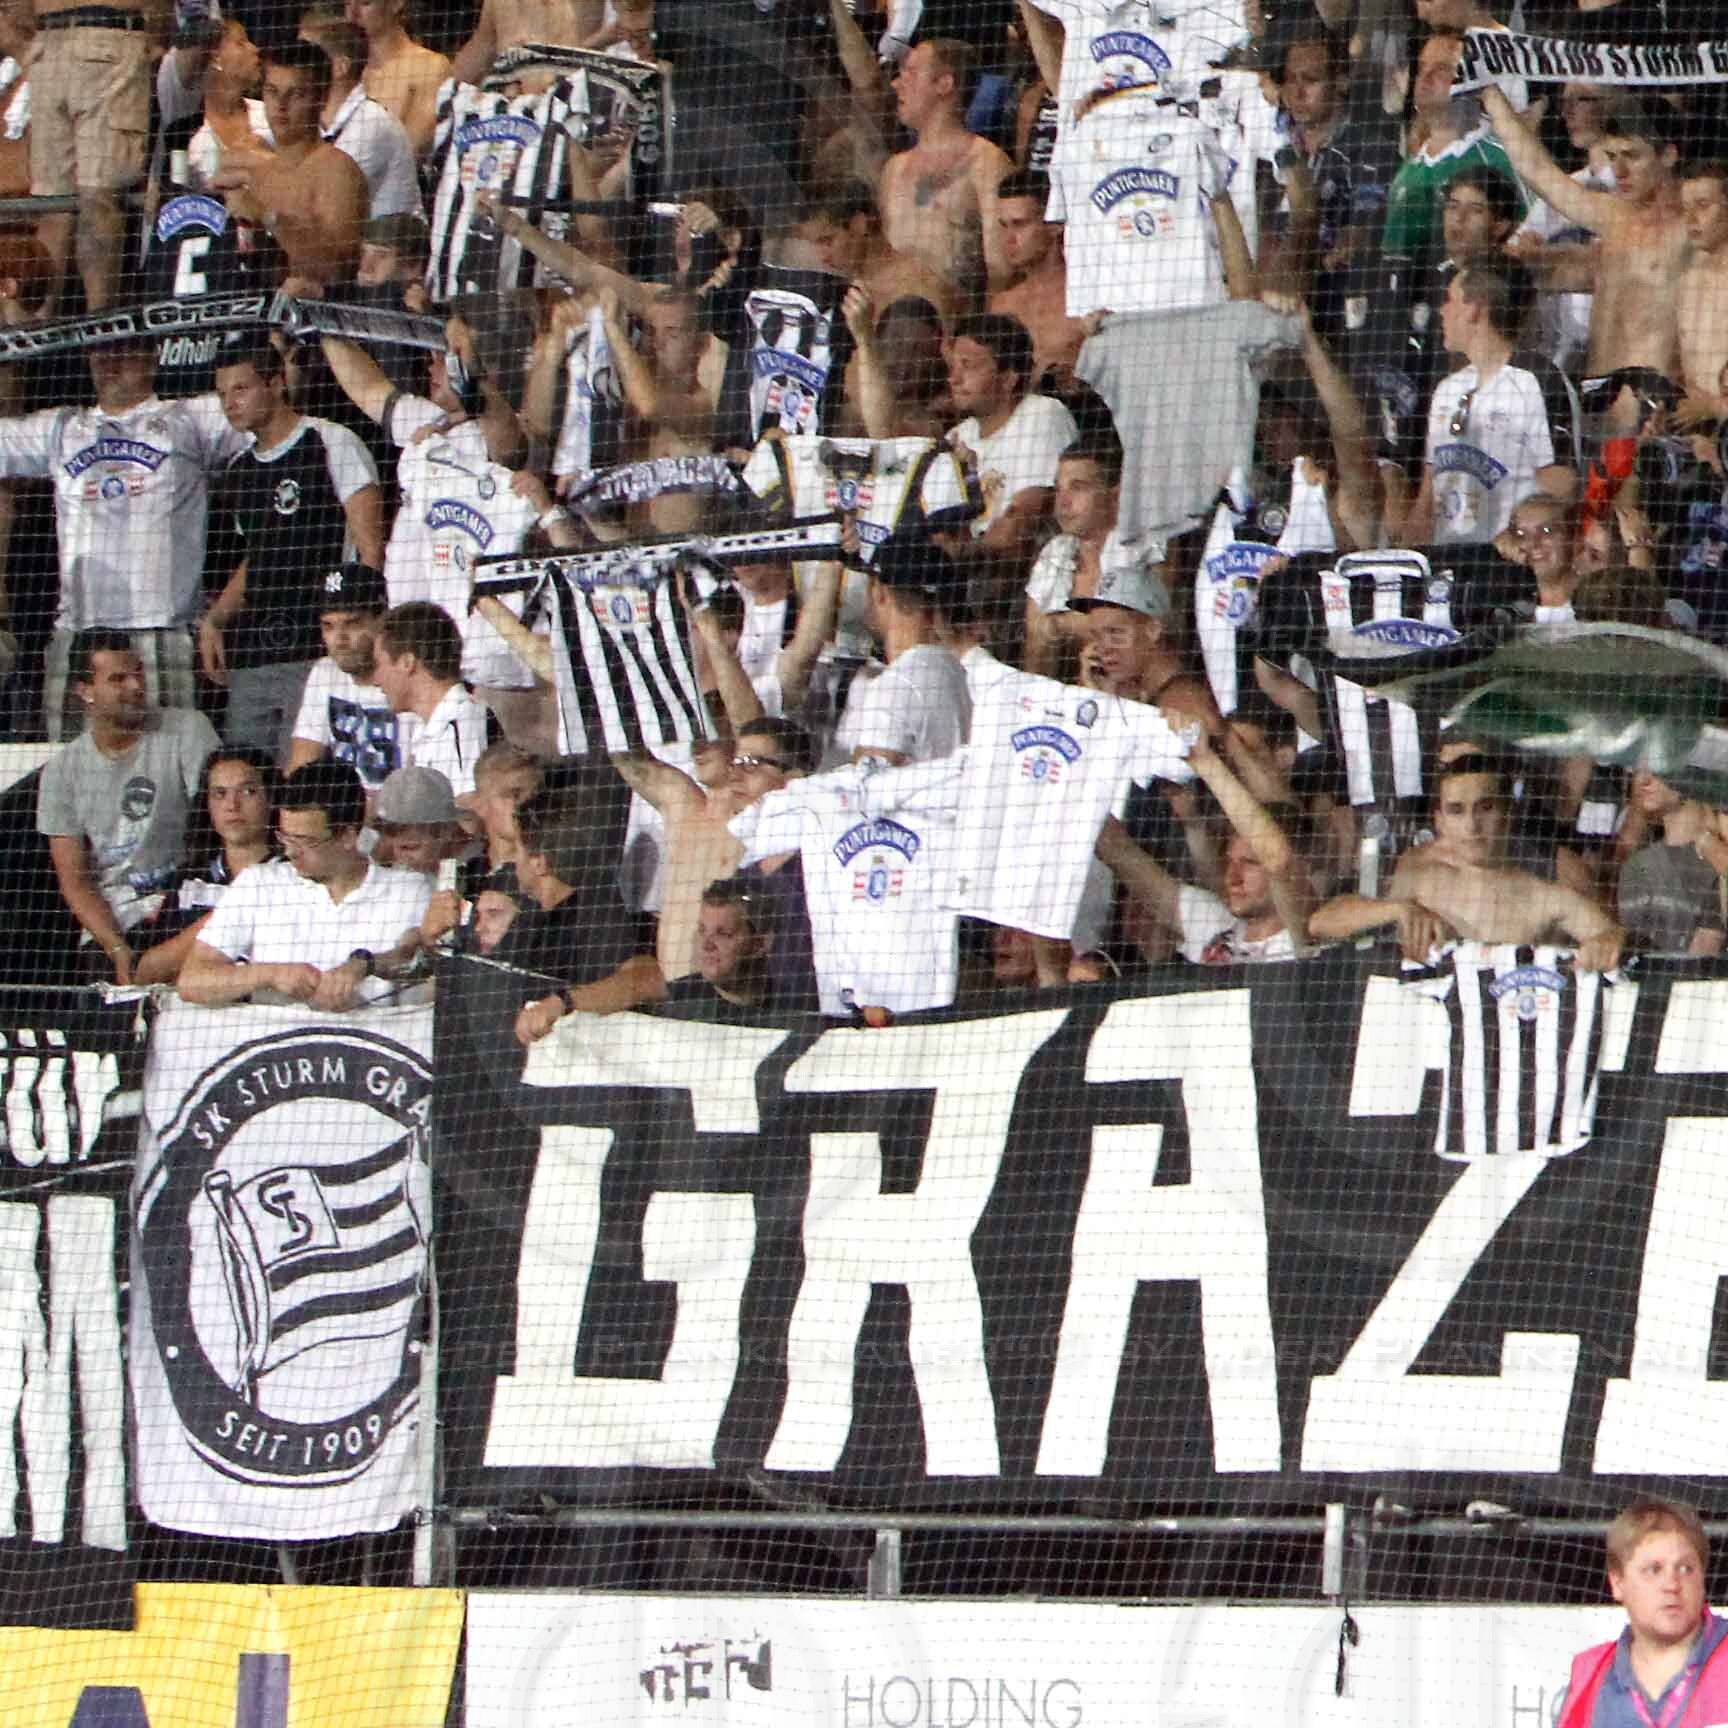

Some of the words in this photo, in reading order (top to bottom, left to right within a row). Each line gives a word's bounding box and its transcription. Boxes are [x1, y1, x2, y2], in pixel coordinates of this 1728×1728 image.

[1611, 37, 1703, 79] STURM
[1090, 168, 1180, 215] PUNTIGAMER
[65, 438, 169, 480] PUNTIGAMER
[836, 817, 921, 866] PUNTIGAMER
[194, 1106, 233, 1150] SK
[237, 1055, 346, 1106] STURM
[366, 1066, 434, 1136] GRA
[216, 1412, 291, 1460] SEIT
[304, 1413, 383, 1466] 1909
[842, 1673, 1082, 1728] HOLDING
